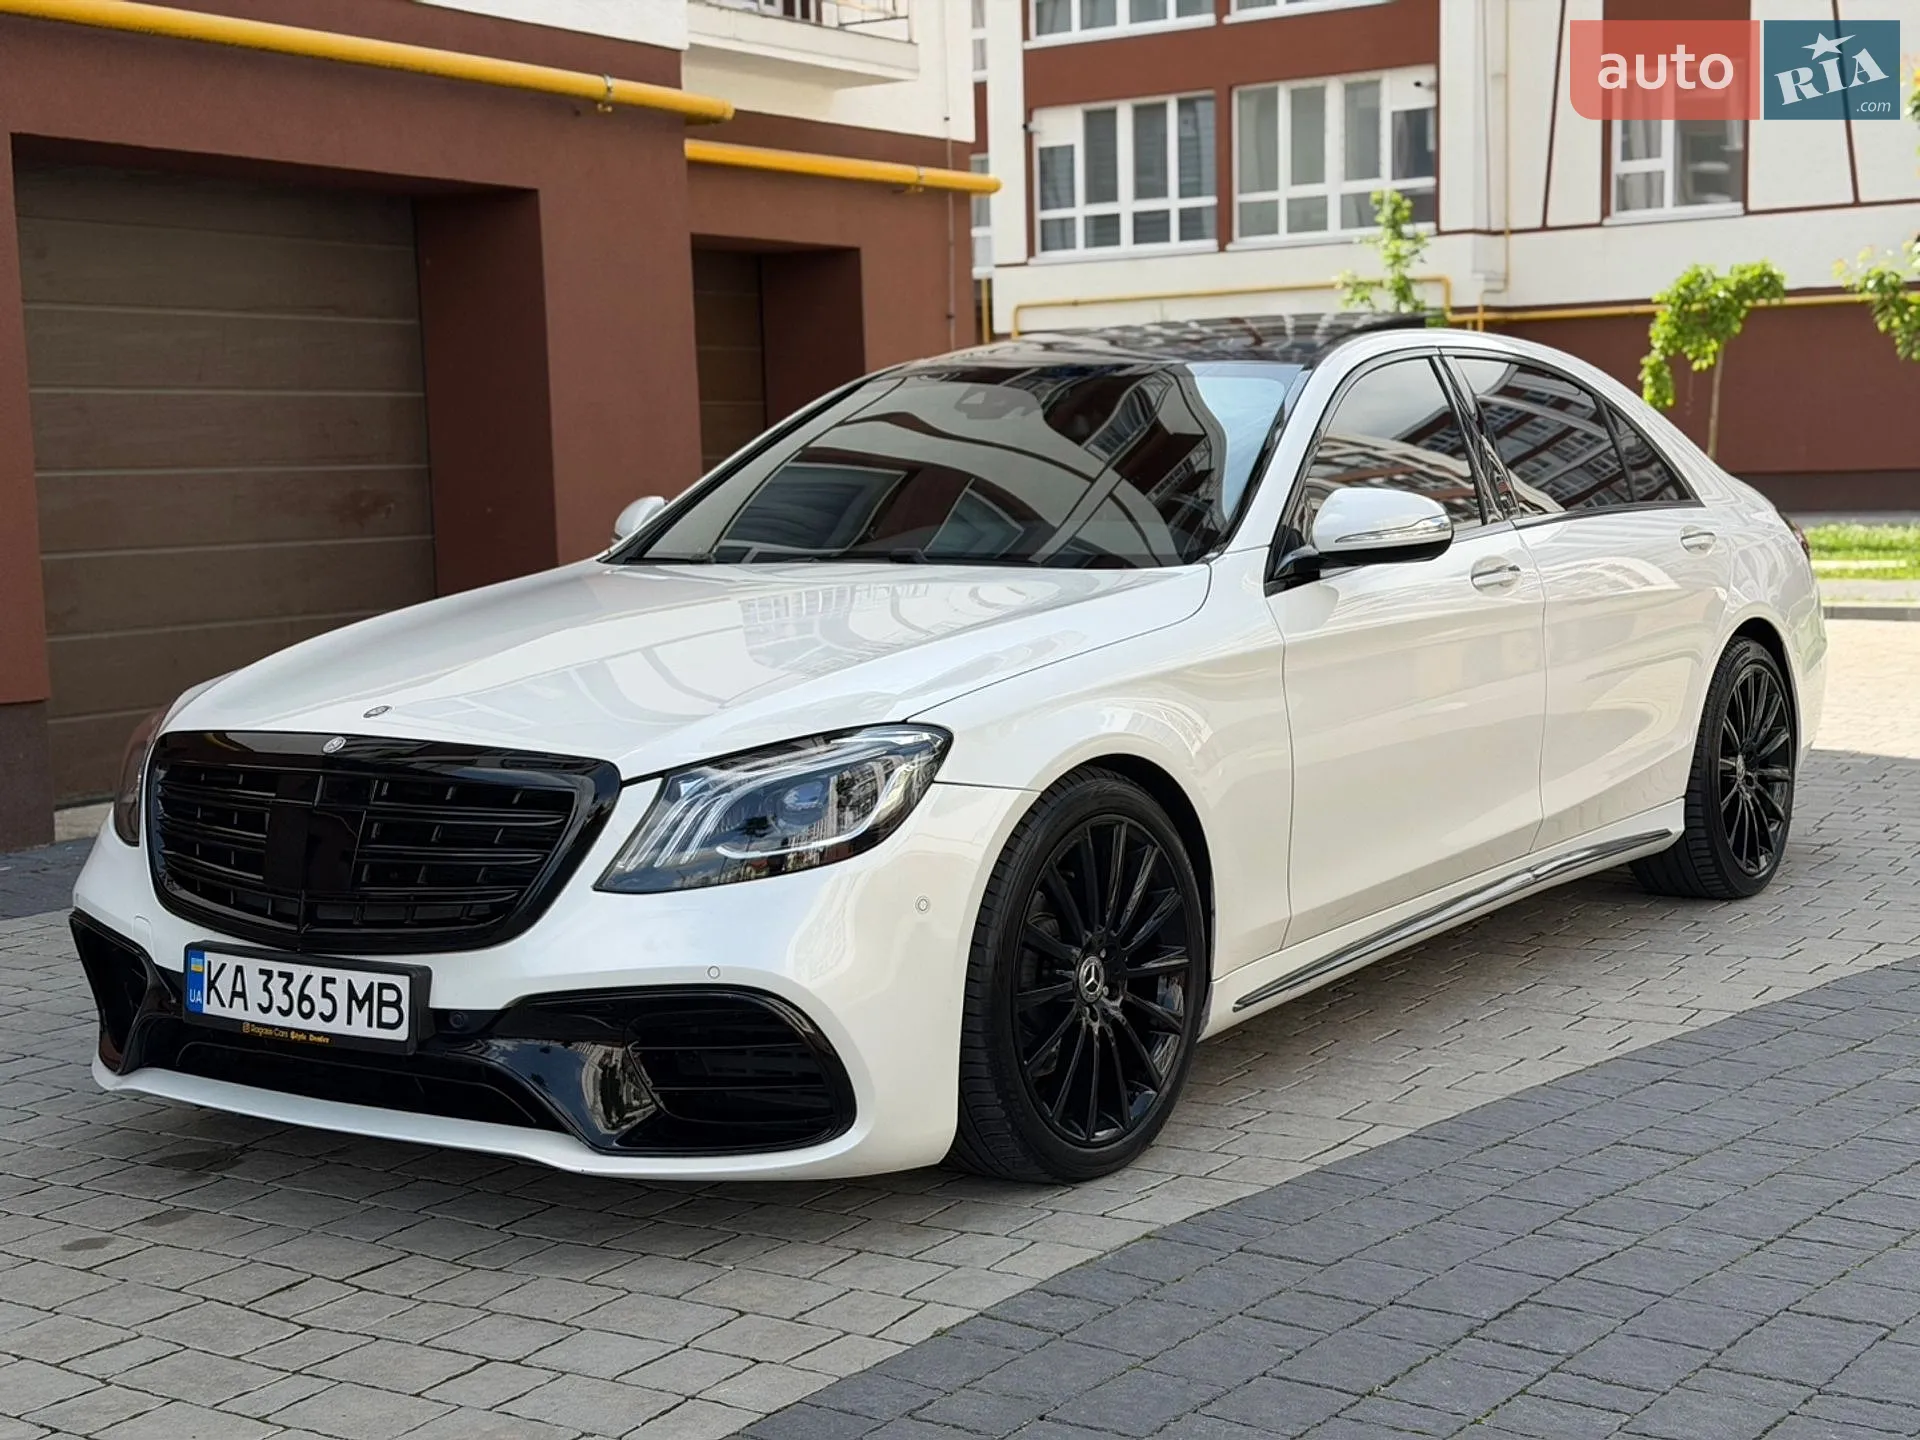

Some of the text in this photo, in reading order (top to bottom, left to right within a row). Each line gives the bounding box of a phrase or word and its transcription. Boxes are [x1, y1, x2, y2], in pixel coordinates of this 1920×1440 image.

[189, 988, 203, 1005] UA
[206, 959, 404, 1031] KA 3365 MB
